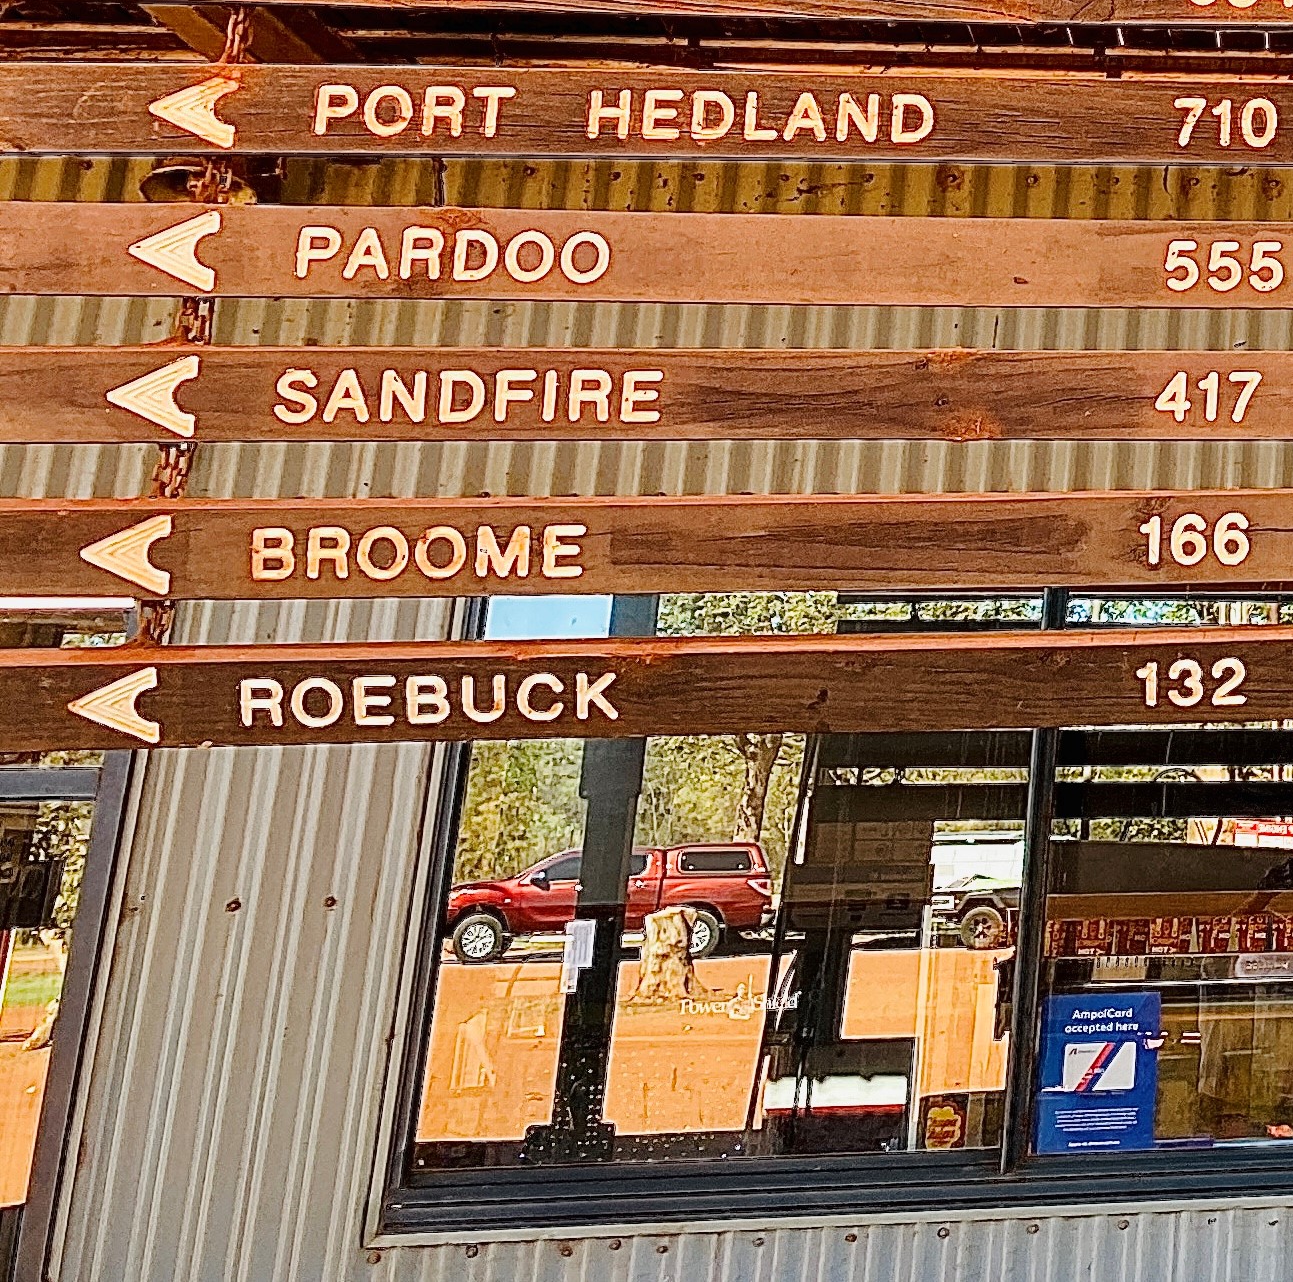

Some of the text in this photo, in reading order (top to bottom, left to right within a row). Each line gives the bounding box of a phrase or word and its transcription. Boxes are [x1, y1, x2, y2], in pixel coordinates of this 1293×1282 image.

[312, 82, 519, 140] PORT
[585, 87, 936, 146] HEDLAND
[1171, 95, 1280, 150] 710
[294, 224, 612, 286] PARDOO
[1162, 238, 1286, 294] 555
[271, 366, 666, 426] SANDFIRE
[1152, 369, 1265, 425] 417
[249, 522, 589, 582] BROOME
[1137, 510, 1252, 568] 166
[237, 670, 621, 730] ROEBUCK
[1134, 654, 1250, 709] 132
[1065, 1022, 1113, 1034] accepted
